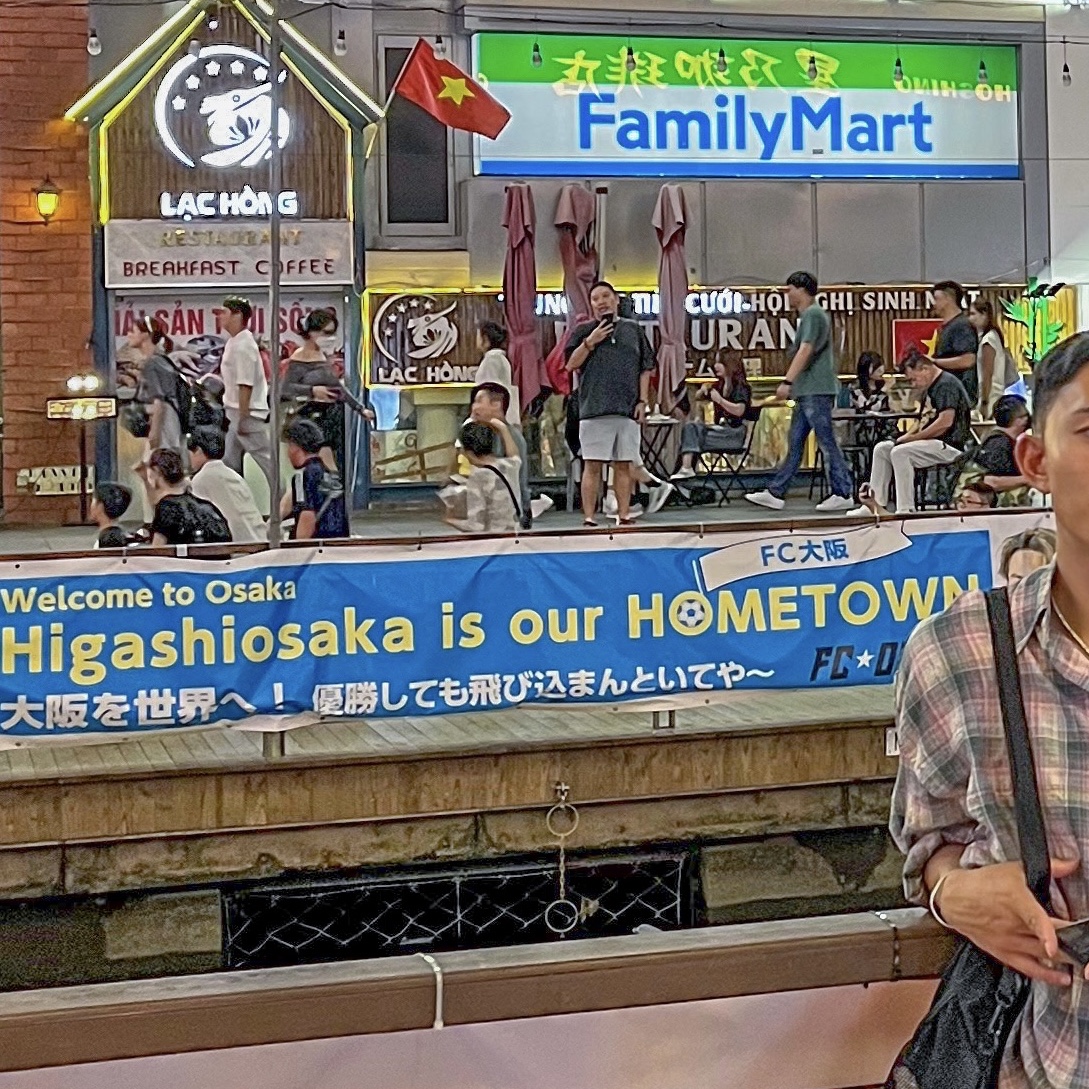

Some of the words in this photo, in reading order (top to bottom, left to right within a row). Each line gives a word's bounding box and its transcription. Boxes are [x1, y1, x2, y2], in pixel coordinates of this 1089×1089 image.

[578, 92, 934, 160] FamilyMart
[123, 260, 240, 277] BREAKFAST
[1, 582, 152, 614] Welcome
[162, 582, 195, 607] to
[205, 575, 297, 605] Osaka
[2, 605, 414, 686] Higashiosaka
[441, 602, 485, 650] is
[508, 604, 604, 645] our
[810, 644, 855, 682] FC
